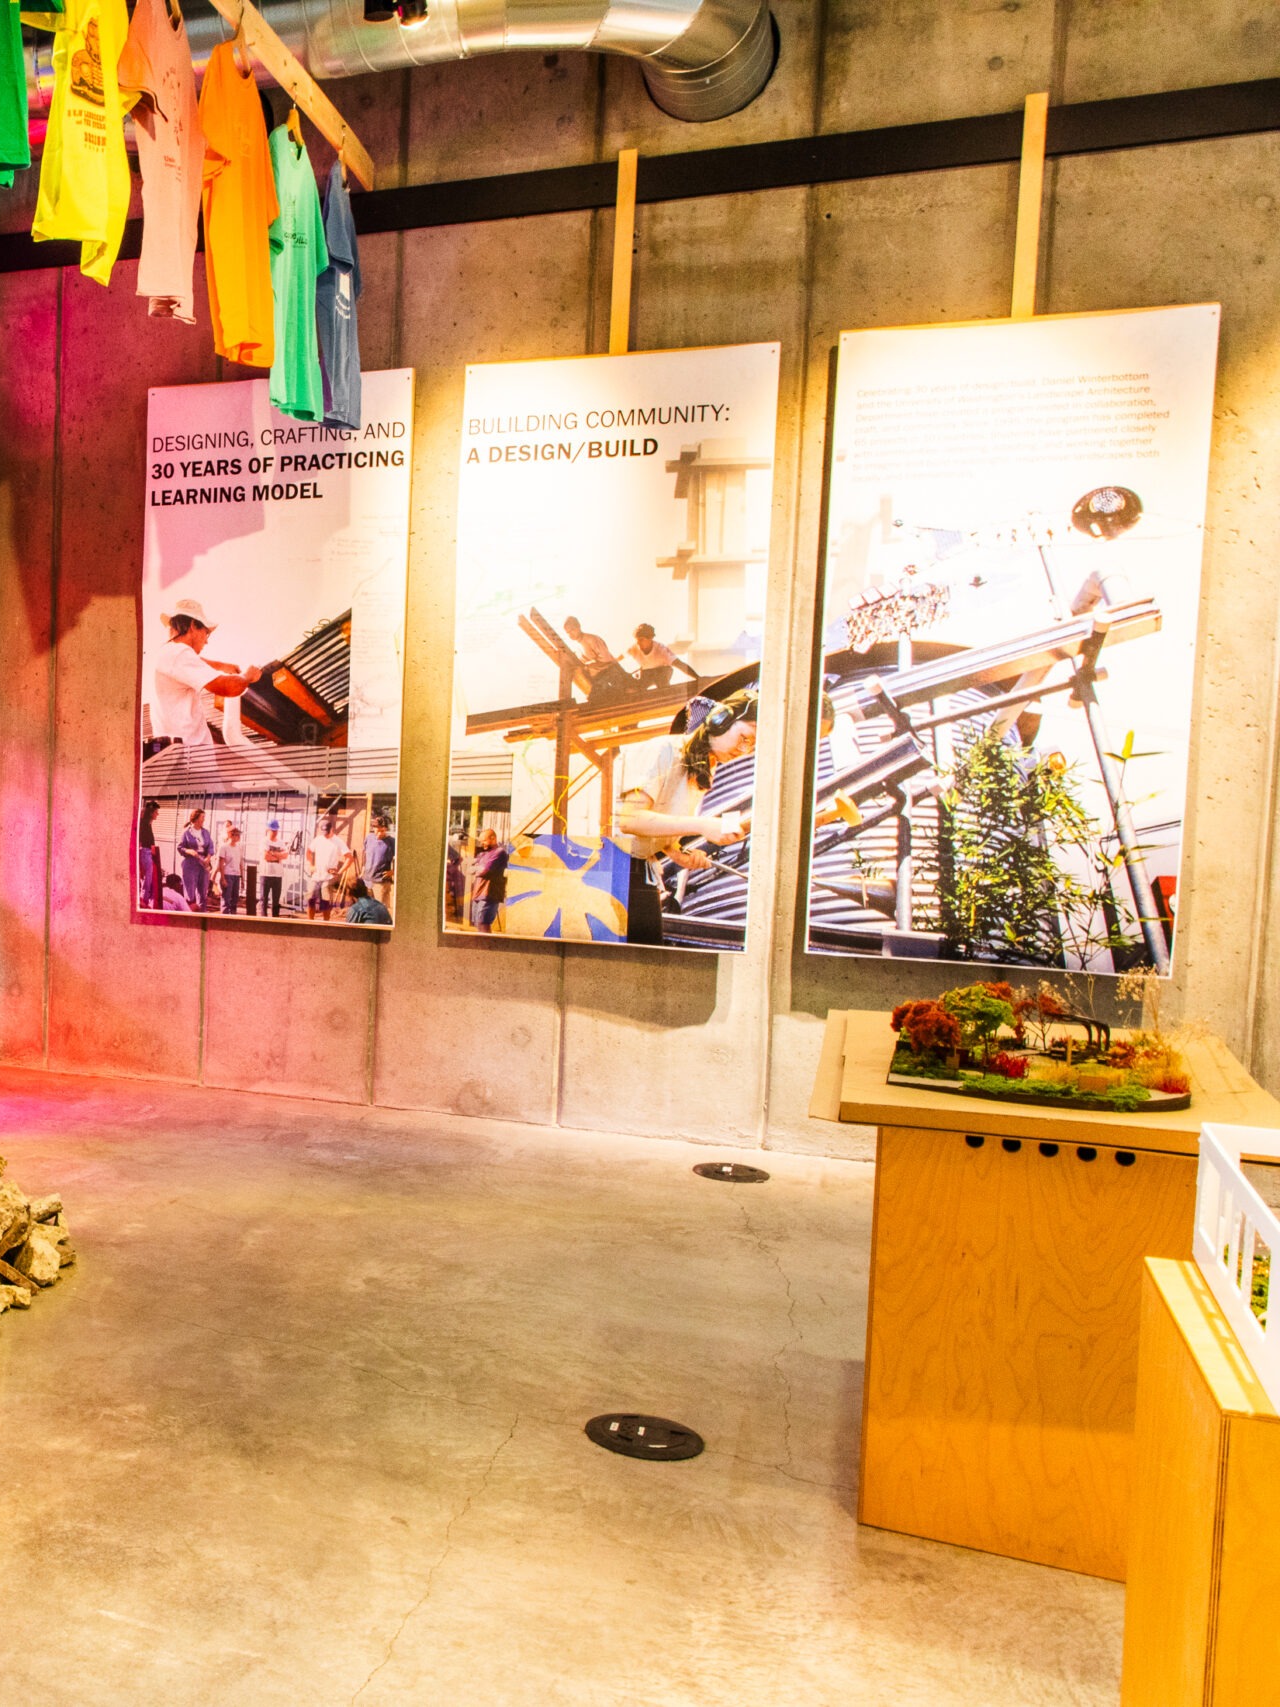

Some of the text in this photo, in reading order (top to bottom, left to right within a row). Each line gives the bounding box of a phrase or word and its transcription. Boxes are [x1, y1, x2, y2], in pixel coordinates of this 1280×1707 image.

[1078, 372, 1149, 384] Winterbottom
[877, 399, 892, 408] the
[1087, 386, 1151, 396] Architecture
[1085, 398, 1156, 409] collaboration,
[468, 404, 731, 435] BULILDING COMMUNITY:
[1115, 410, 1170, 420] completed
[1121, 423, 1157, 434] closely
[152, 422, 406, 453] DESIGNING, CRAFTING, AND
[1109, 436, 1153, 447] together
[466, 438, 659, 464] A DESIGN/BUILD
[1136, 449, 1160, 458] both
[151, 450, 405, 480] 30 YEARS OF PRACTICING
[151, 483, 323, 506] LEARNING MODEL
